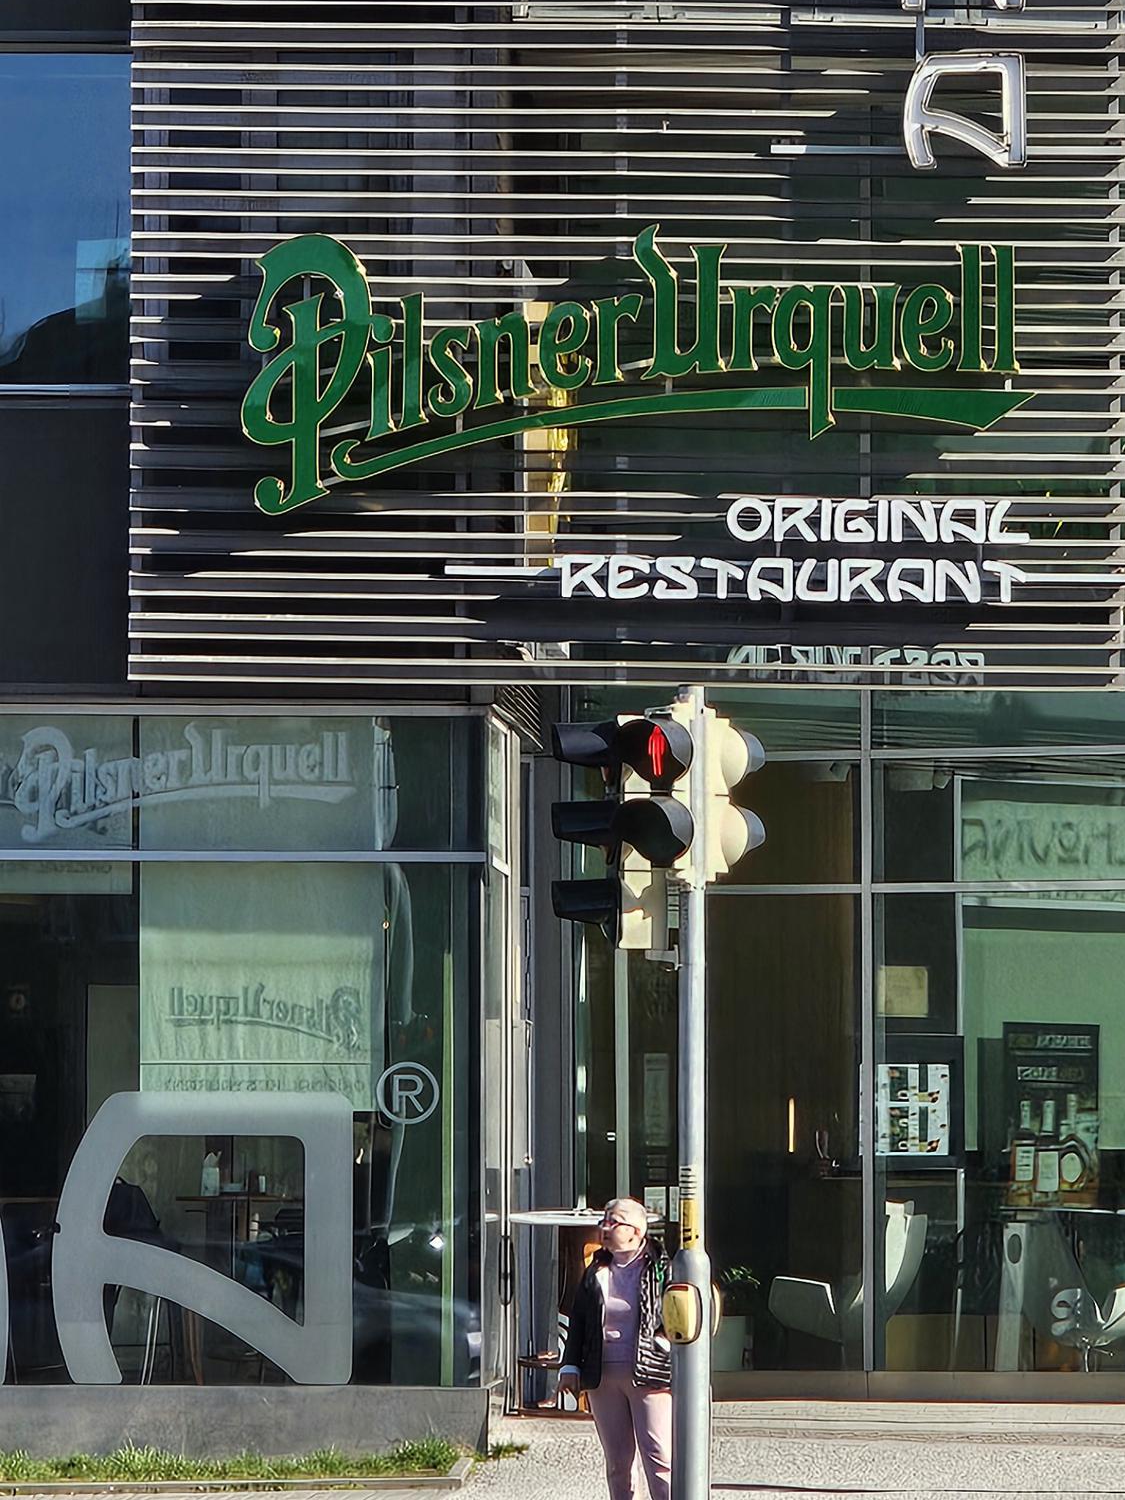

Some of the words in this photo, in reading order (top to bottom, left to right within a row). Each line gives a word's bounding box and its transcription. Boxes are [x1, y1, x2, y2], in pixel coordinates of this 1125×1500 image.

[240, 232, 643, 515] Pilsner
[633, 223, 1021, 441] Urquell
[726, 497, 1030, 544] ORIGINAL
[554, 555, 1028, 603] RESTAURANT
[13, 726, 188, 843] Pilsner
[183, 721, 352, 809] Urquell
